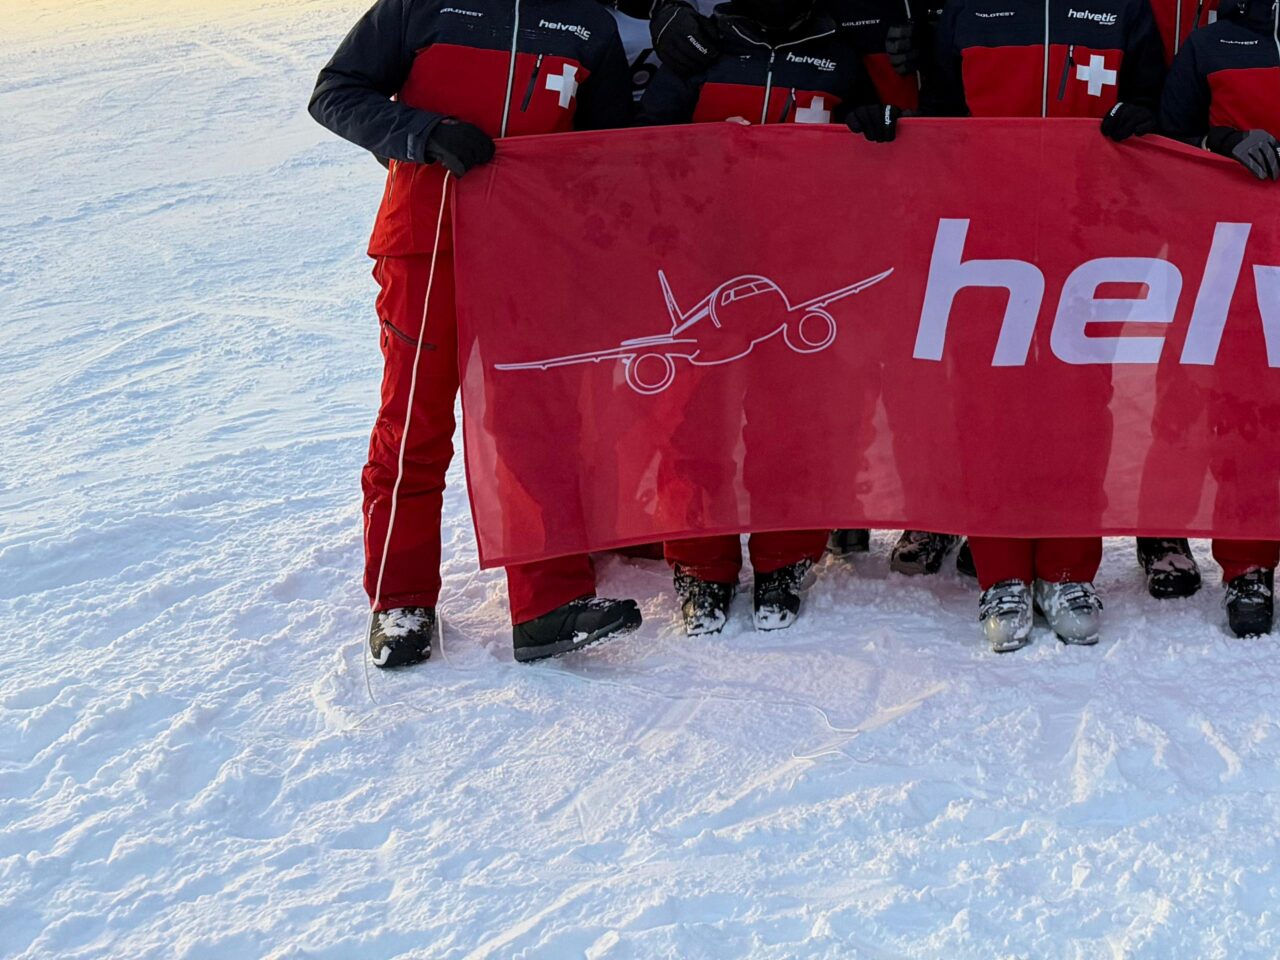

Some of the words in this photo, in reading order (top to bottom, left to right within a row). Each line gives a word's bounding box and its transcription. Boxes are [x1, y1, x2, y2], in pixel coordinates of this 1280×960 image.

[1067, 8, 1118, 23] helvetic
[538, 19, 592, 40] helvetic
[687, 35, 709, 55] reusch
[786, 52, 838, 70] helvetic
